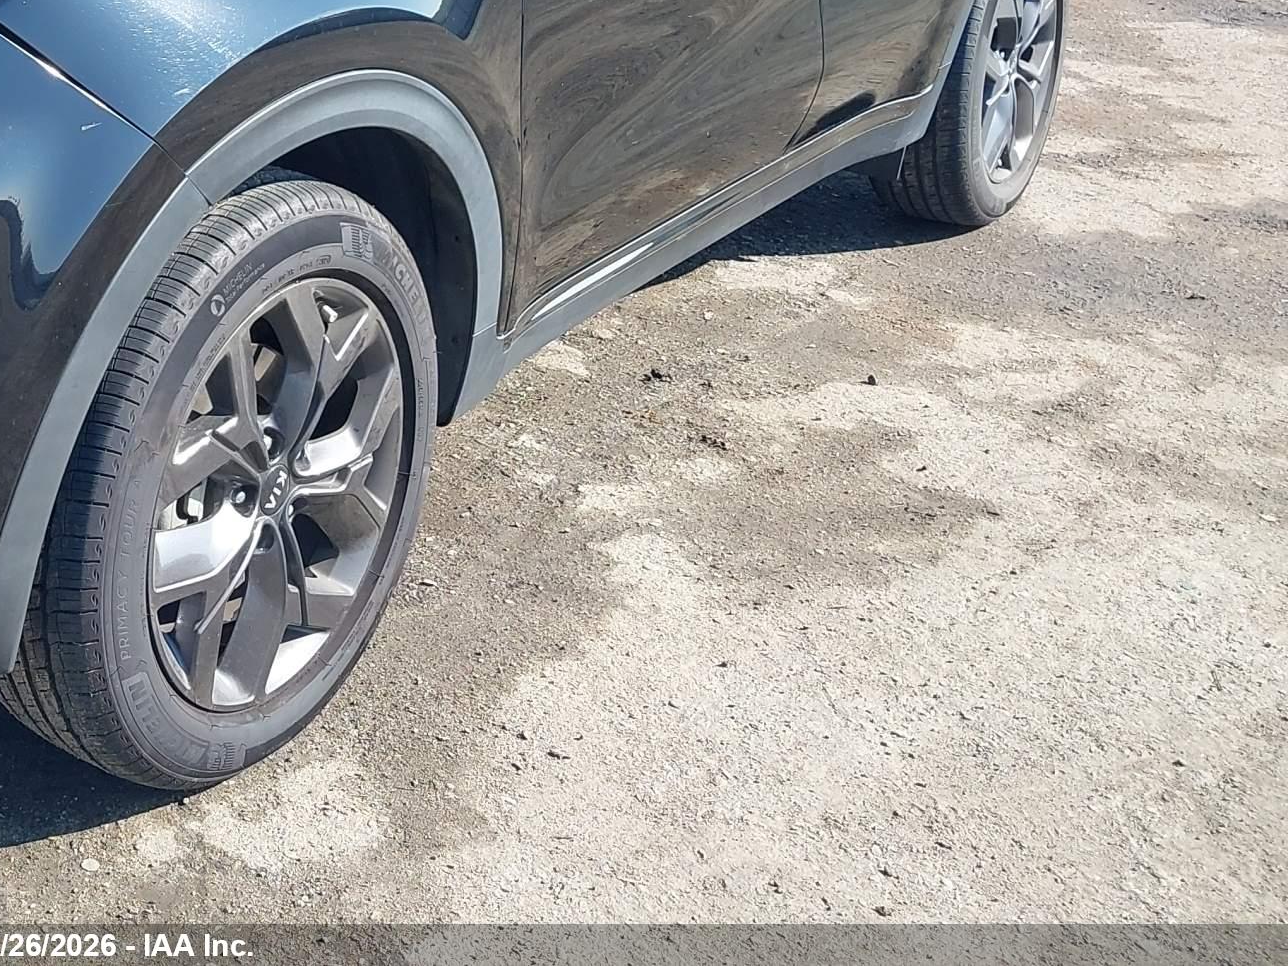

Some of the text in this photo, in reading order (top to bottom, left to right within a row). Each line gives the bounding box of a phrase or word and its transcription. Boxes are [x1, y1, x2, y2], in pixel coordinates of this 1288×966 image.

[264, 470, 288, 509] KIA
[117, 499, 139, 660] PRIMACY TOUR
